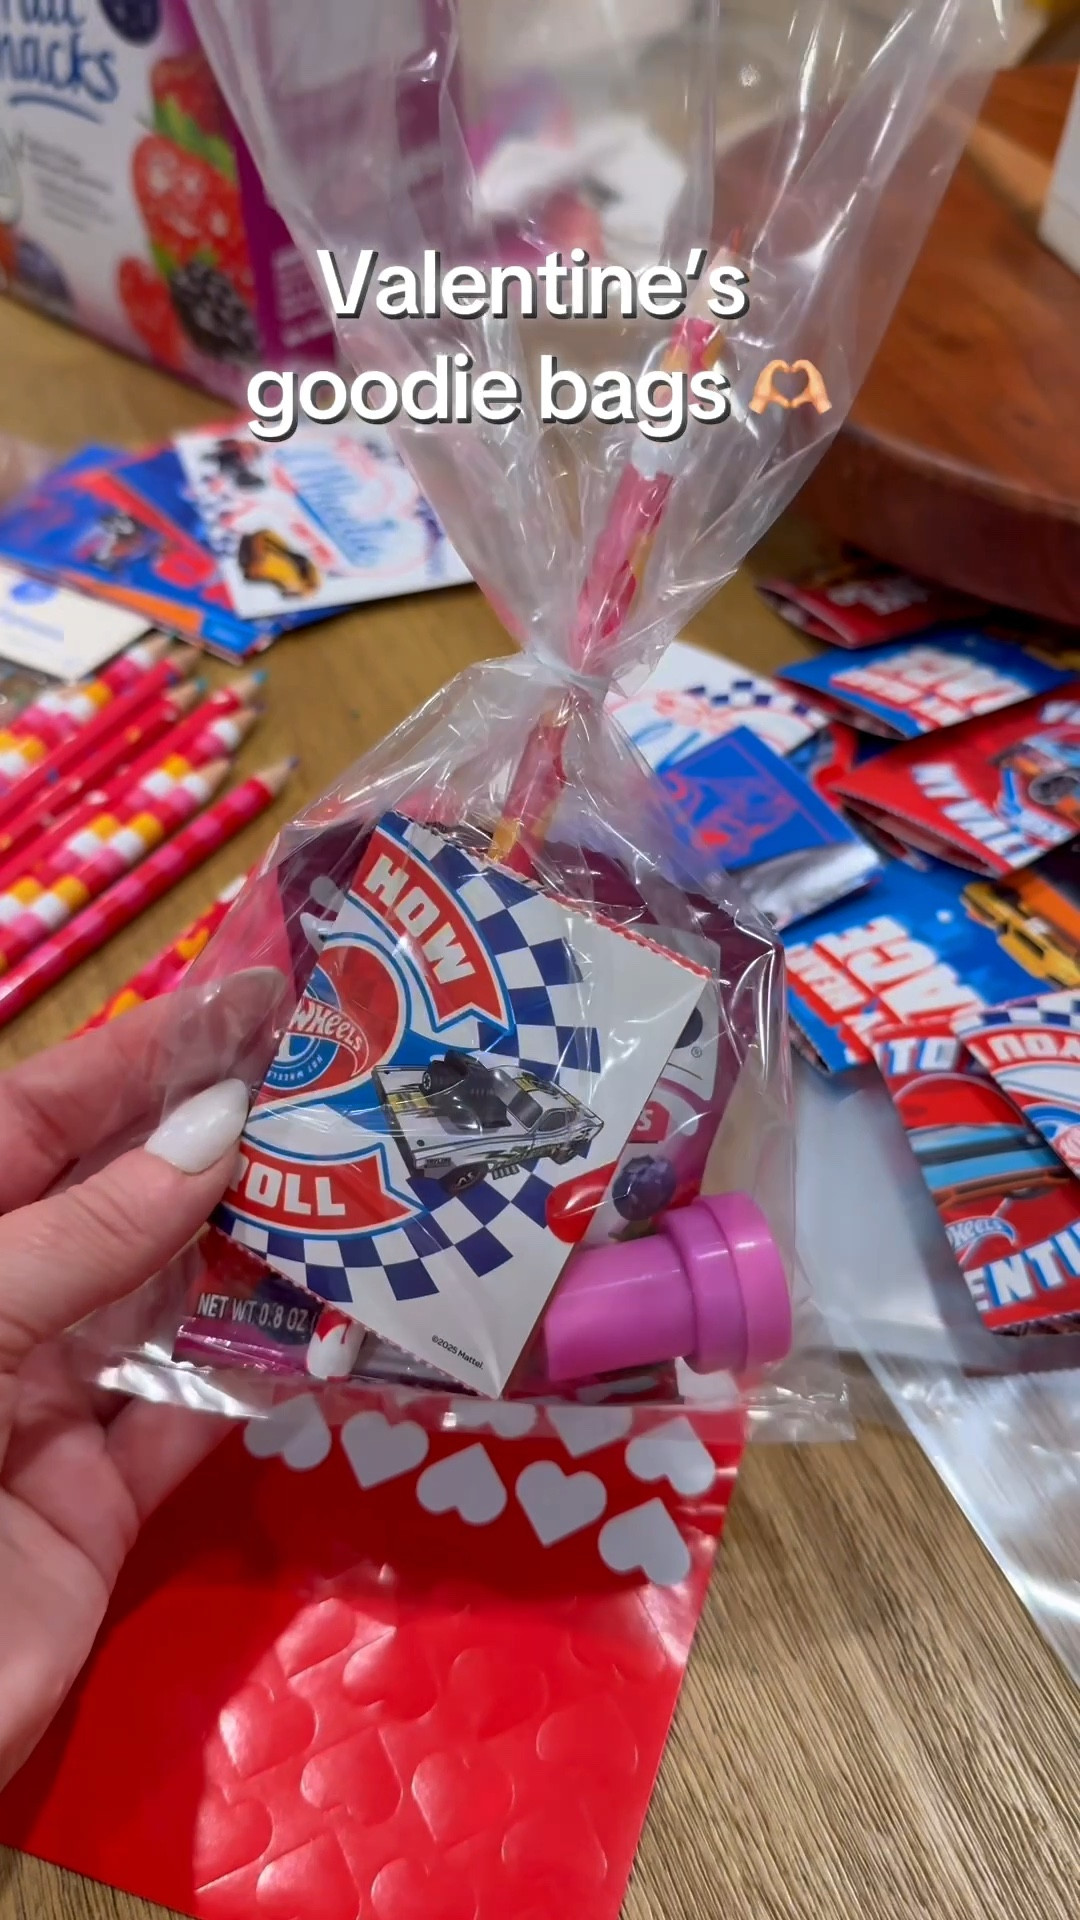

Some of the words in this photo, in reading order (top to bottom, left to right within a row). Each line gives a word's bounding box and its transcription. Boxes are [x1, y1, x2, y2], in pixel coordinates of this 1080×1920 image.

[363, 852, 476, 985] HOW
[814, 916, 985, 1026] ACE
[963, 1219, 1080, 1311] ENTI
[197, 1292, 229, 1318] NET
[231, 1298, 257, 1324] WT
[258, 1302, 284, 1329] 0.8
[286, 1307, 309, 1331] OZ
[432, 1335, 458, 1355] ©2025
